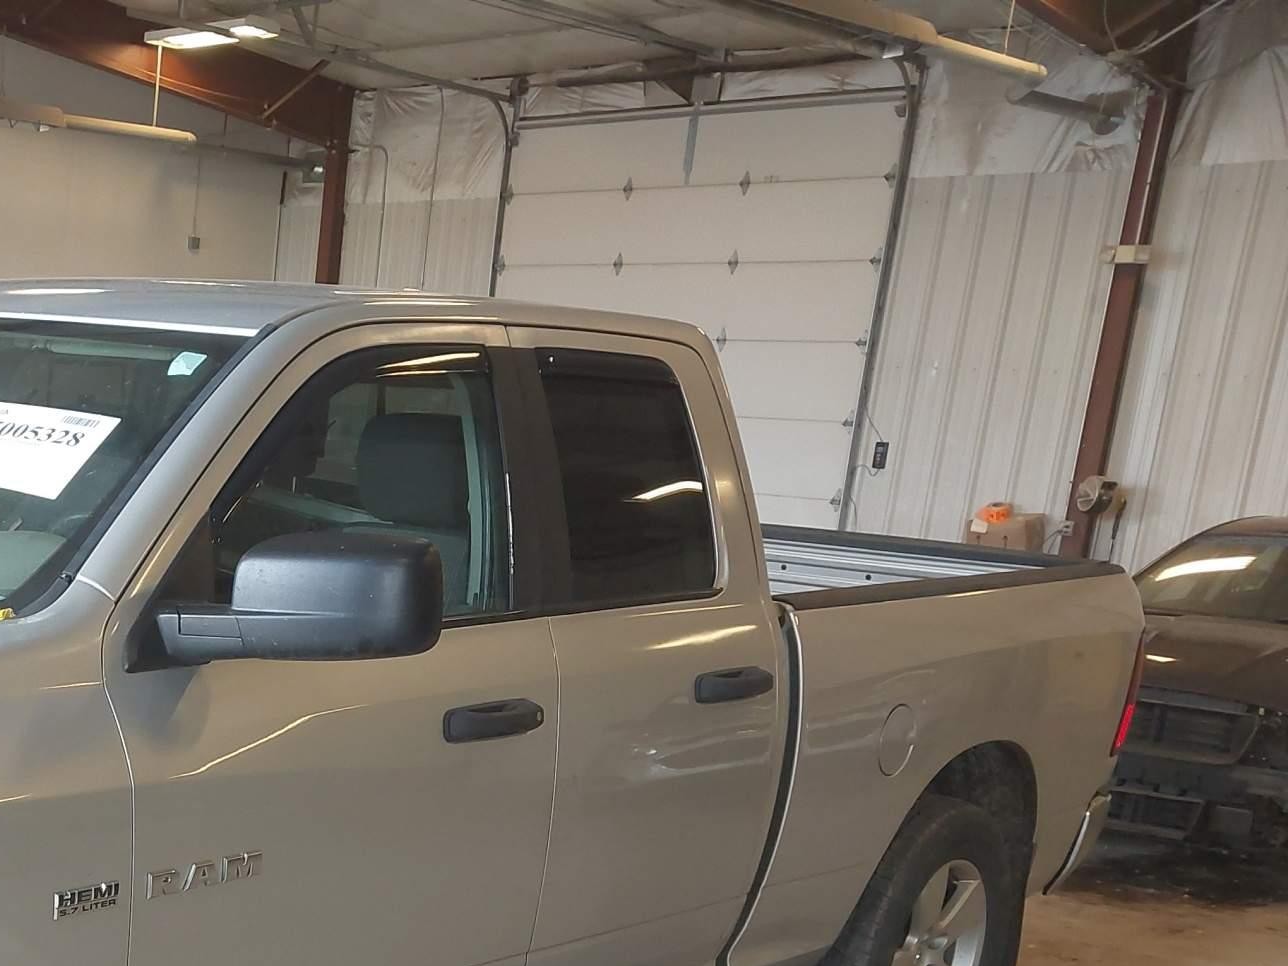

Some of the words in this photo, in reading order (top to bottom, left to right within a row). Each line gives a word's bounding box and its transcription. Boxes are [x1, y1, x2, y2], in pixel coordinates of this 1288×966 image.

[145, 850, 263, 900] RAM
[53, 882, 120, 908] HEMI
[82, 899, 116, 912] LITER
